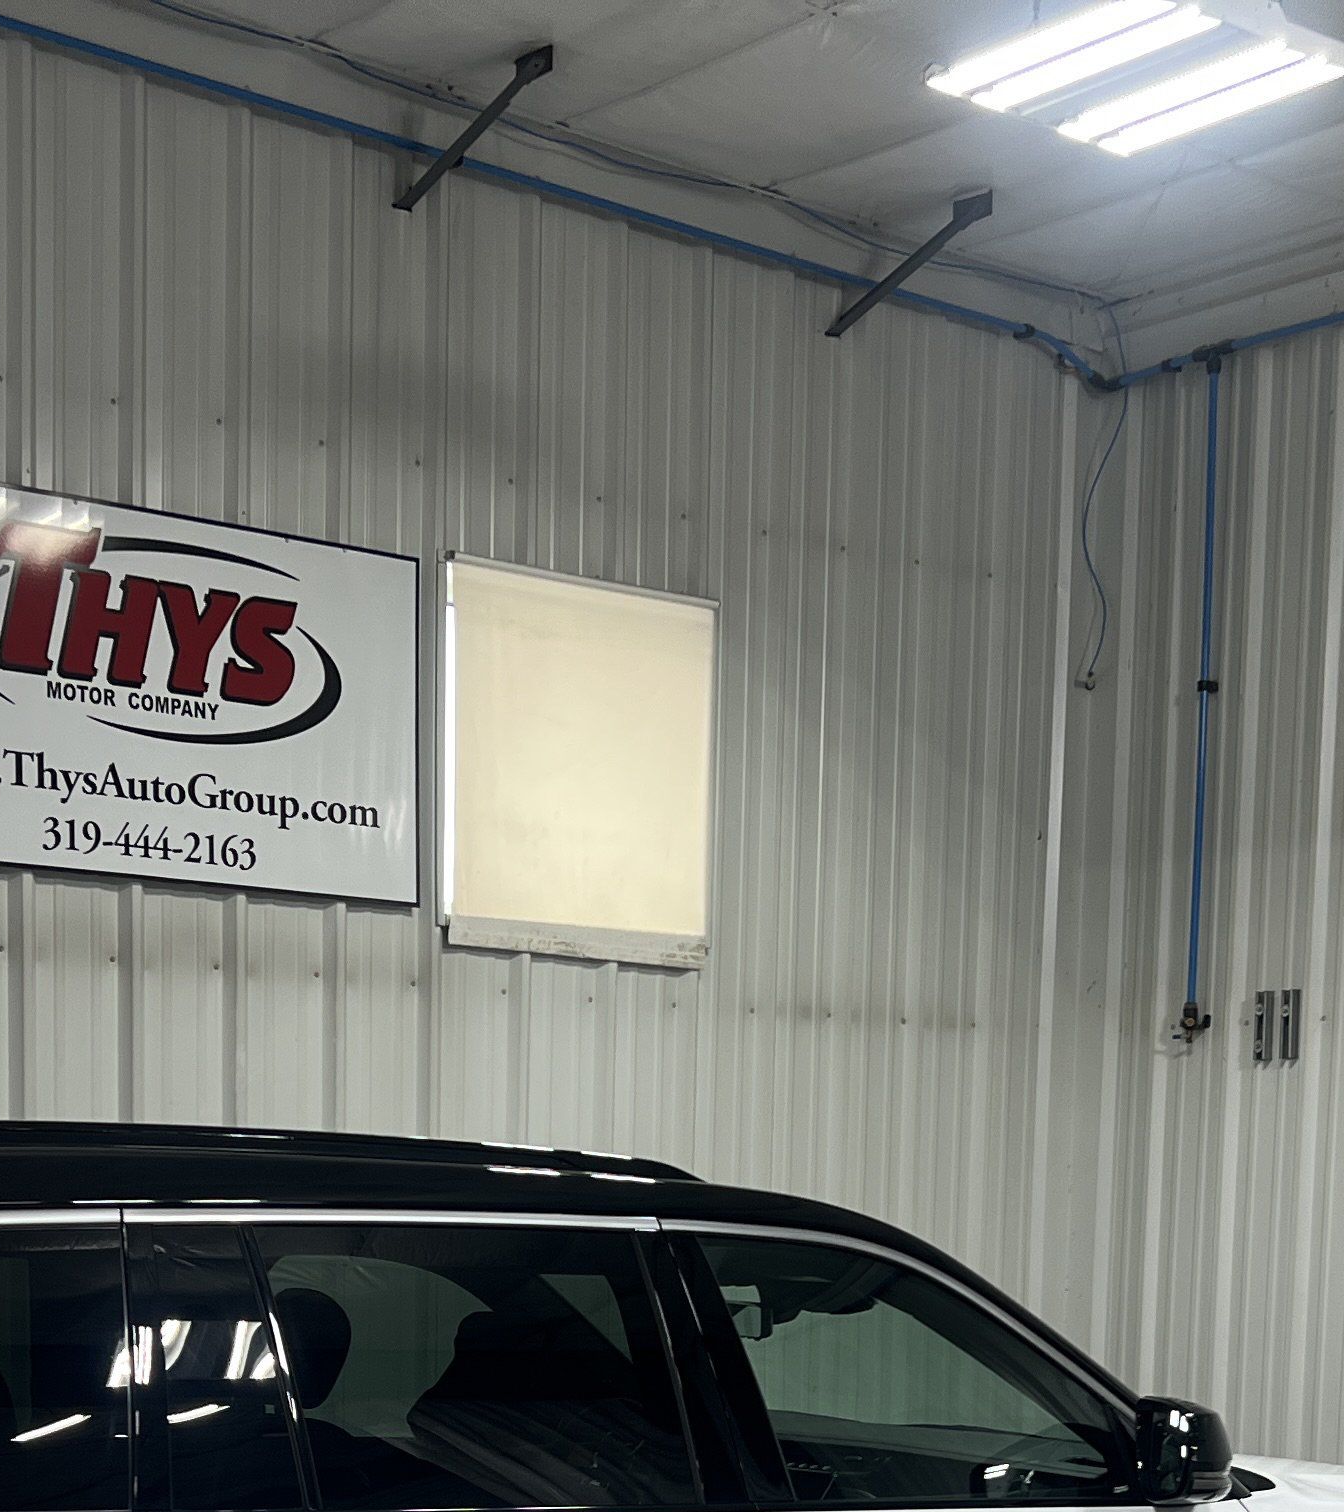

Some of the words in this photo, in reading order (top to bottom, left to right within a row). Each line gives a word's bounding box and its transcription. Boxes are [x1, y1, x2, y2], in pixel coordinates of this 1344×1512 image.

[46, 680, 116, 708] MOTOR
[128, 692, 220, 721] COMPANY
[42, 816, 257, 871] 319-444-2163
